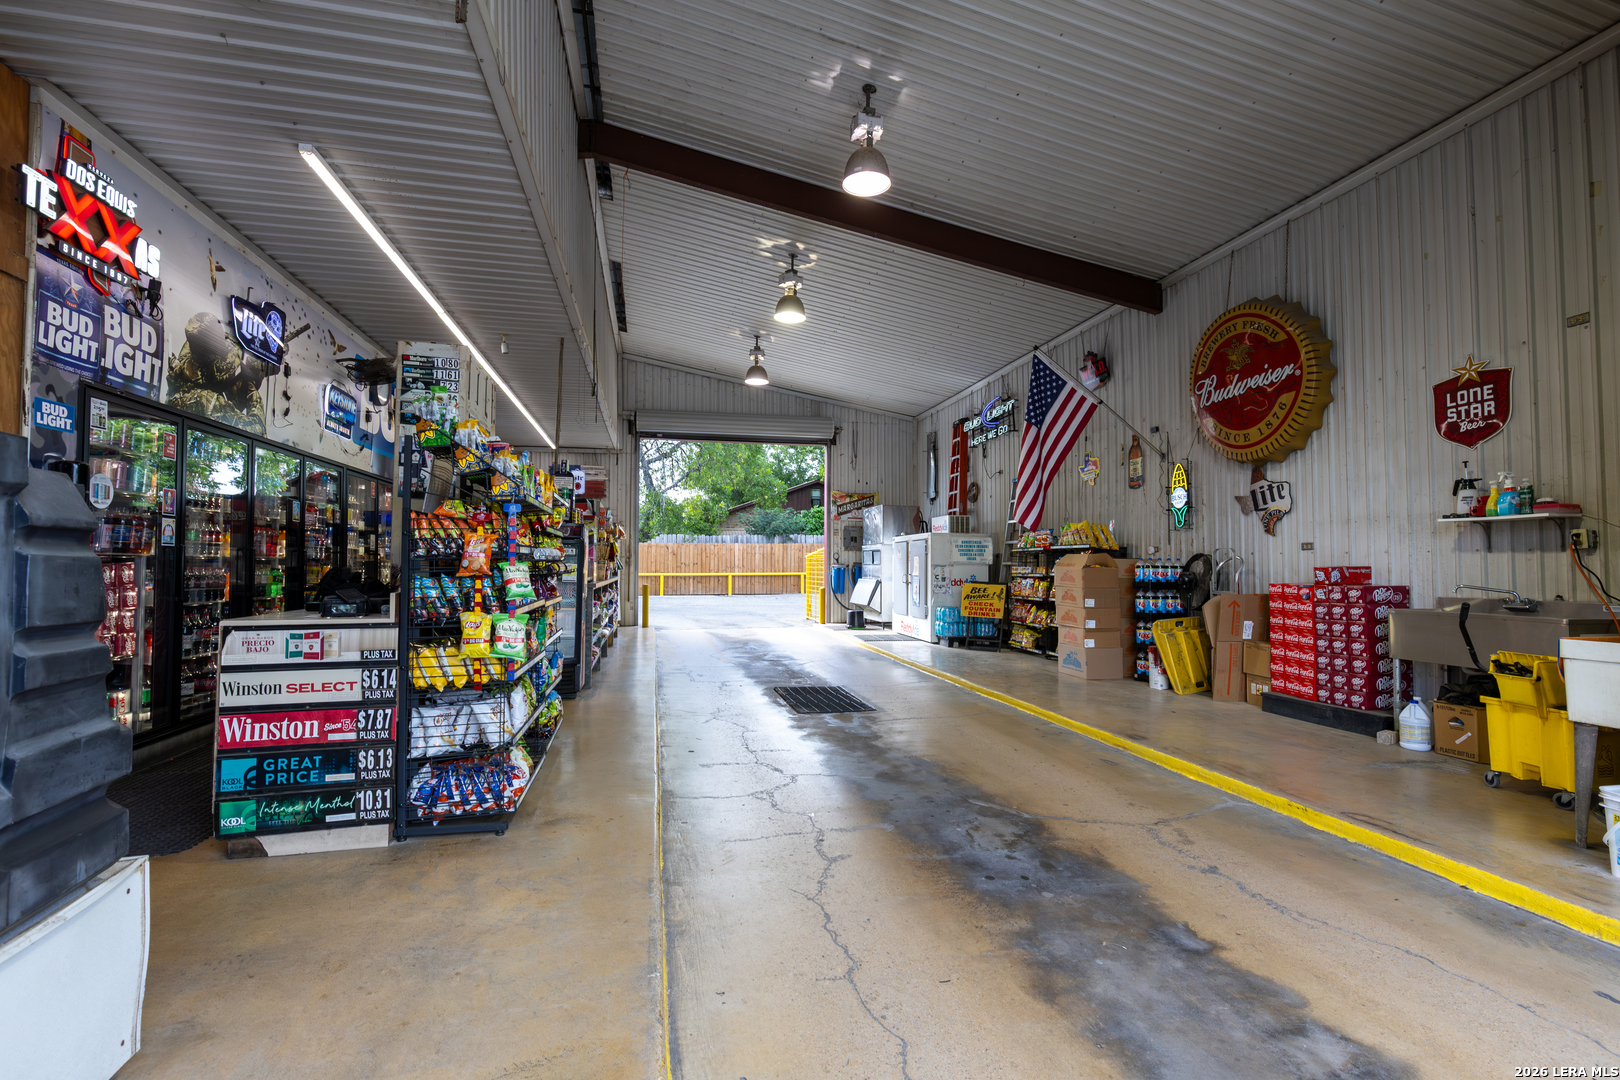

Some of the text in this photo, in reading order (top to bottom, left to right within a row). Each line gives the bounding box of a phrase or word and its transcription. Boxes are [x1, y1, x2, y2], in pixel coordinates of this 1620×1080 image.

[66, 158, 137, 218] DOS EQUIS
[63, 241, 129, 285] SINCE 1897
[47, 300, 94, 338] BUD
[104, 304, 158, 354] BUD
[38, 320, 99, 362] LIGHT
[1201, 320, 1280, 369] BREWERY FRESH
[101, 338, 160, 386] IGHT
[1080, 365, 1093, 381] WE
[1195, 363, 1295, 409] Budweiser
[1447, 384, 1494, 407] LONE
[41, 401, 68, 418] BUD
[964, 399, 1015, 432] BUD LIGHT
[1447, 400, 1496, 423] STAR
[36, 411, 73, 431] LIGHT
[1212, 401, 1288, 443] SINCE 1876
[1459, 421, 1487, 433] Beer
[971, 424, 1008, 447] HERE WE GO
[838, 496, 874, 514] MARGARITAS
[1250, 483, 1287, 512] Lite
[963, 592, 996, 601] AWARE!
[363, 649, 393, 659] PLUS TAX
[222, 681, 282, 697] Winston
[286, 681, 358, 694] SELECT
[362, 669, 397, 689] $6.14
[365, 691, 381, 699] PLUS
[381, 690, 394, 698] TAX
[324, 722, 342, 732] Since
[357, 708, 392, 730] $7.87
[221, 716, 320, 743] Winston
[359, 731, 376, 739] PLUS
[376, 730, 389, 738] TAX
[358, 748, 393, 769] $6.13
[1439, 747, 1475, 759] PLASTIC BOTTLES
[263, 756, 322, 771] GREAT
[222, 778, 243, 786] KOOL
[265, 770, 319, 785] PRICE
[360, 770, 377, 779] PLUS
[377, 770, 391, 779] TAX
[259, 795, 356, 817] Intense Menthol
[359, 811, 376, 820] PLUS
[376, 810, 390, 818] TAX
[221, 817, 246, 827] KOOL
